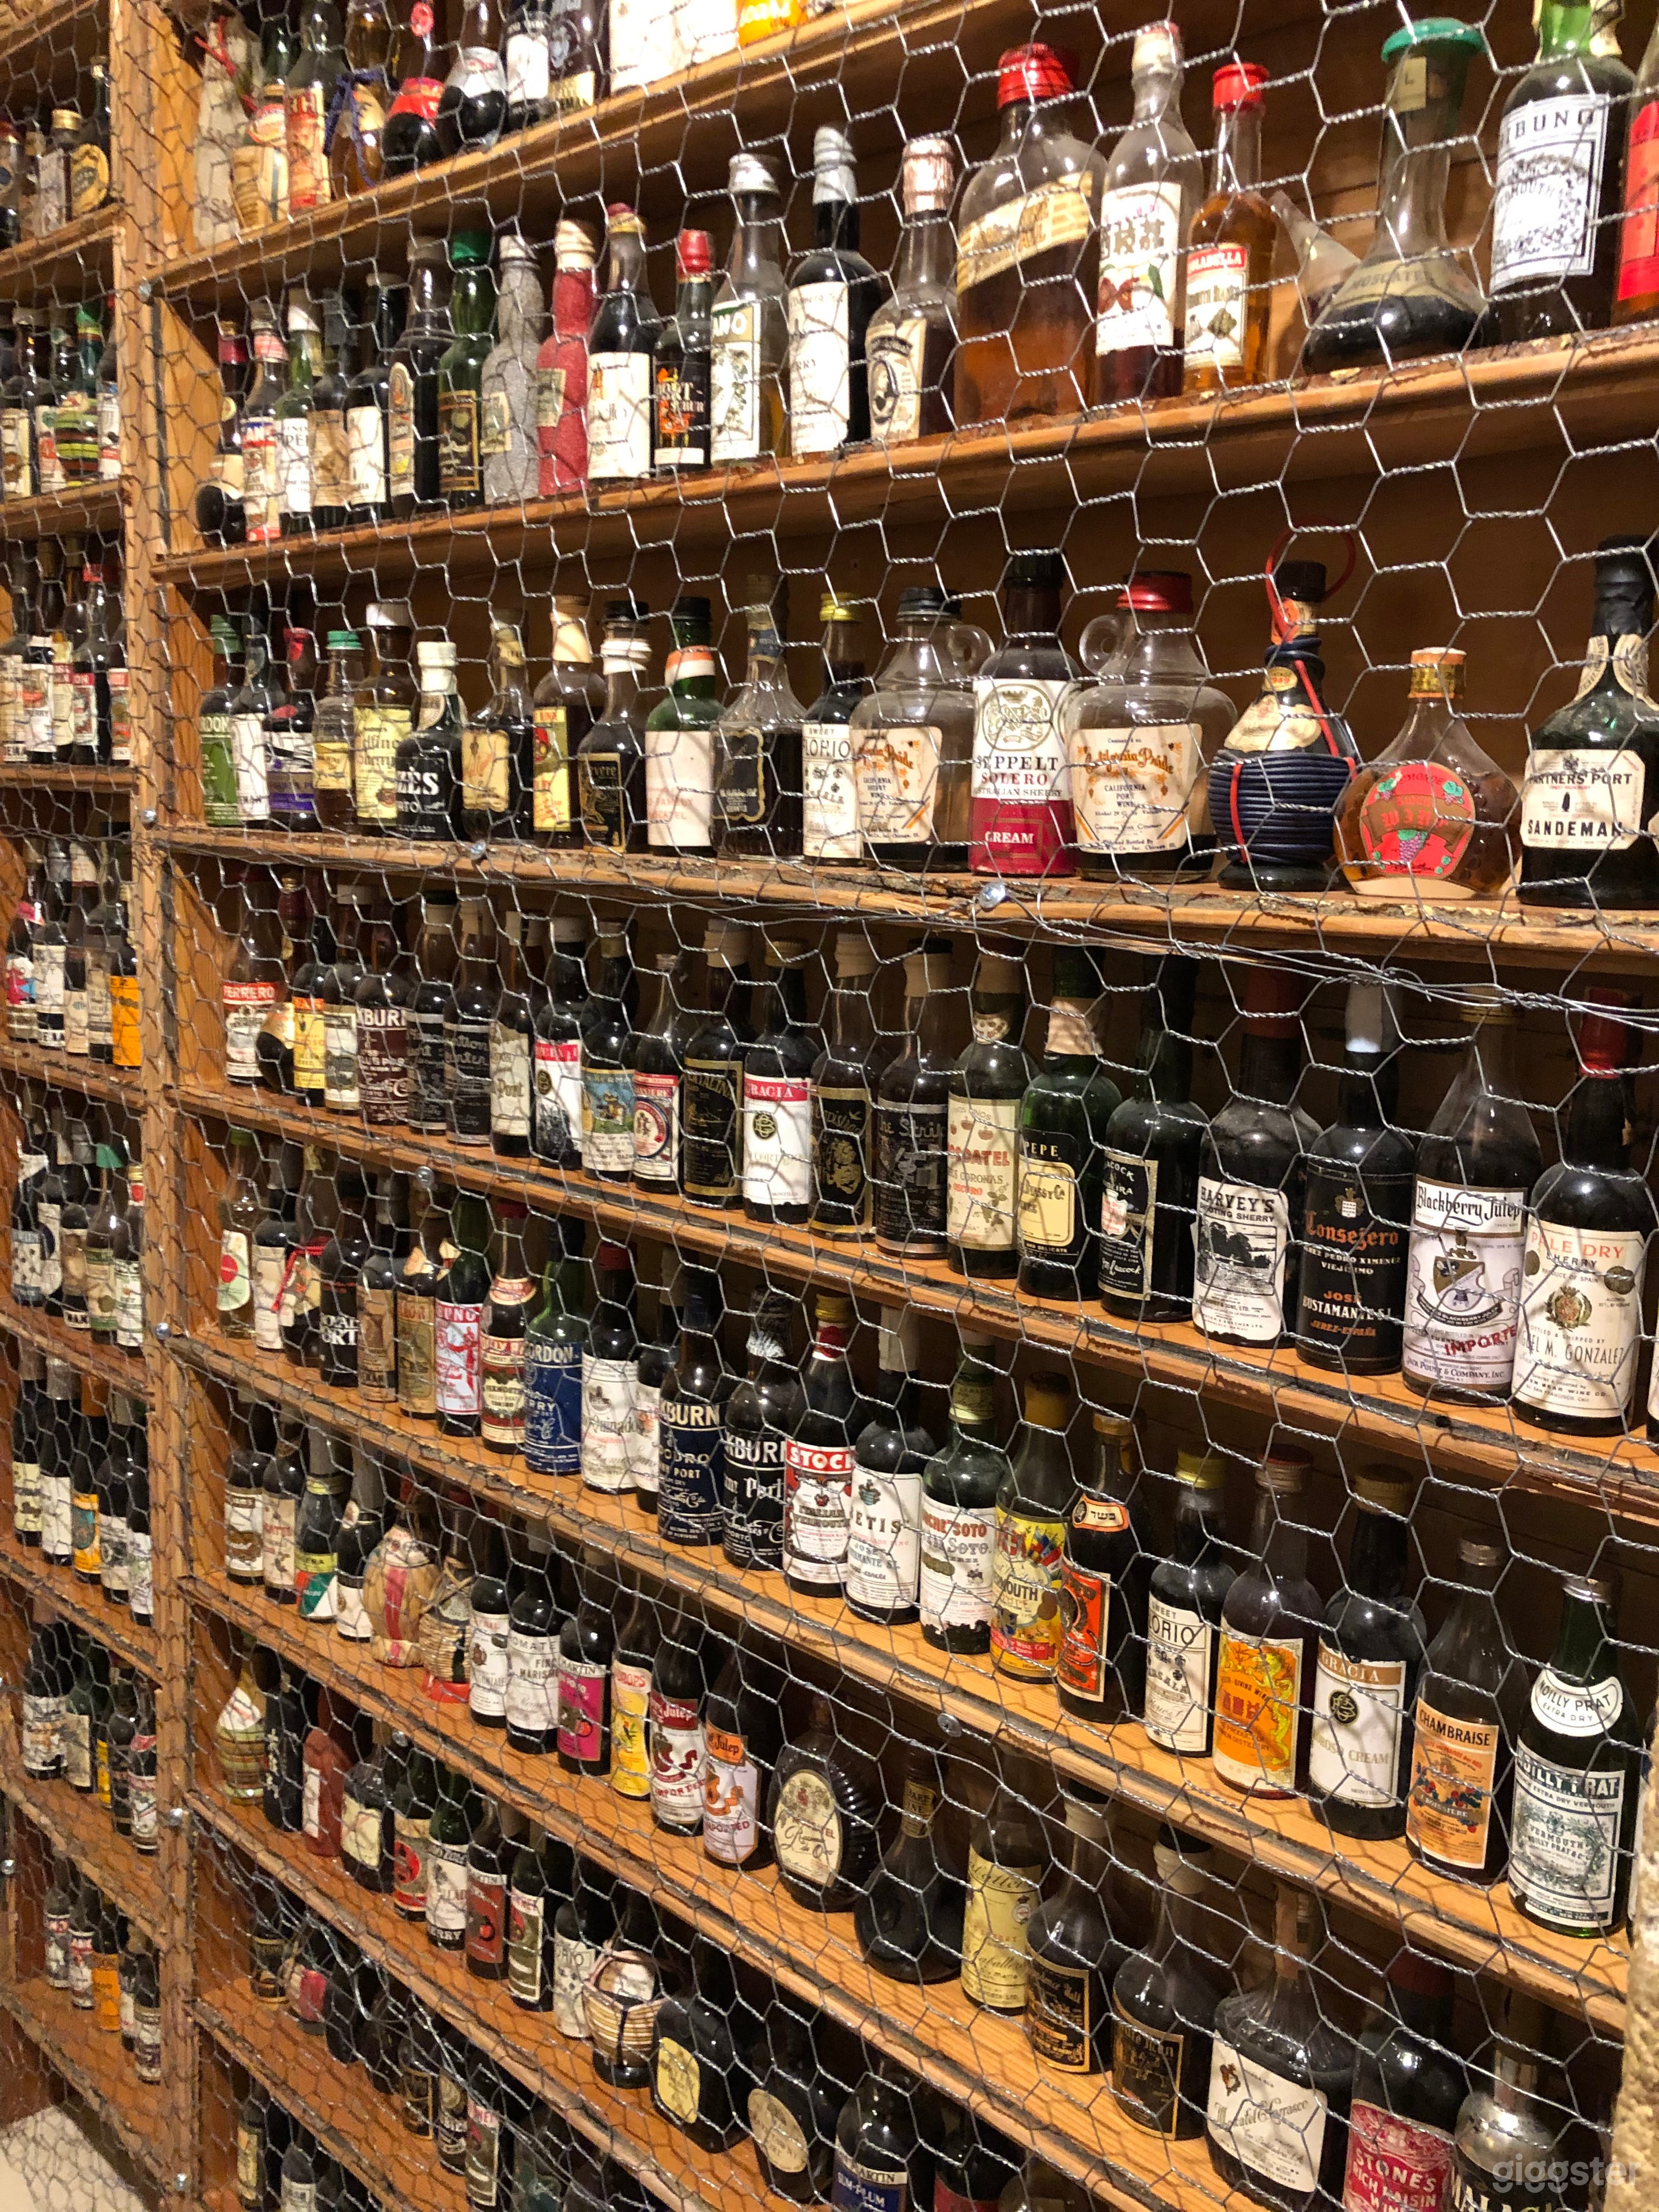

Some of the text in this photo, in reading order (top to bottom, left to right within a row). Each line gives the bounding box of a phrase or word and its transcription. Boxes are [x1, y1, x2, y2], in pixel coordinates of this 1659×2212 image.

[976, 755, 1059, 771] SEPPELT
[981, 772, 1048, 785] SOLERO
[1592, 772, 1634, 785] PORT
[1022, 789, 1063, 797] SHERRY
[1104, 783, 1146, 791] CALIFORNIA
[1528, 819, 1623, 837] SANDEMAN
[984, 831, 1035, 844] CREAM
[1025, 1141, 1058, 1157] PEPE
[960, 1170, 1003, 1184] CORONAS
[1200, 1185, 1275, 1213] HARVEY'S
[1416, 1184, 1521, 1226] Blackberry Julep
[1236, 1213, 1275, 1222] SHERRY
[1531, 1230, 1624, 1259] PALE DRY
[1580, 1275, 1599, 1283] SPAIN
[1562, 1334, 1593, 1343] SHIPPED
[1545, 1340, 1558, 1358] M.
[673, 1467, 701, 1479] PORT
[952, 1522, 988, 1538] SOTO
[1321, 1652, 1381, 1683] GRACIA
[1539, 1680, 1612, 1713] NOILLY PRAT
[1541, 1702, 1568, 1720] EXTRA
[1419, 1709, 1491, 1747] CHAMBRAISE
[713, 1734, 740, 1755] Julep
[1348, 1749, 1389, 1764] CREAM
[1555, 1796, 1571, 1805] DRY
[1351, 2160, 1379, 2190] RICH
[1355, 2148, 1438, 2194] STONE'S
